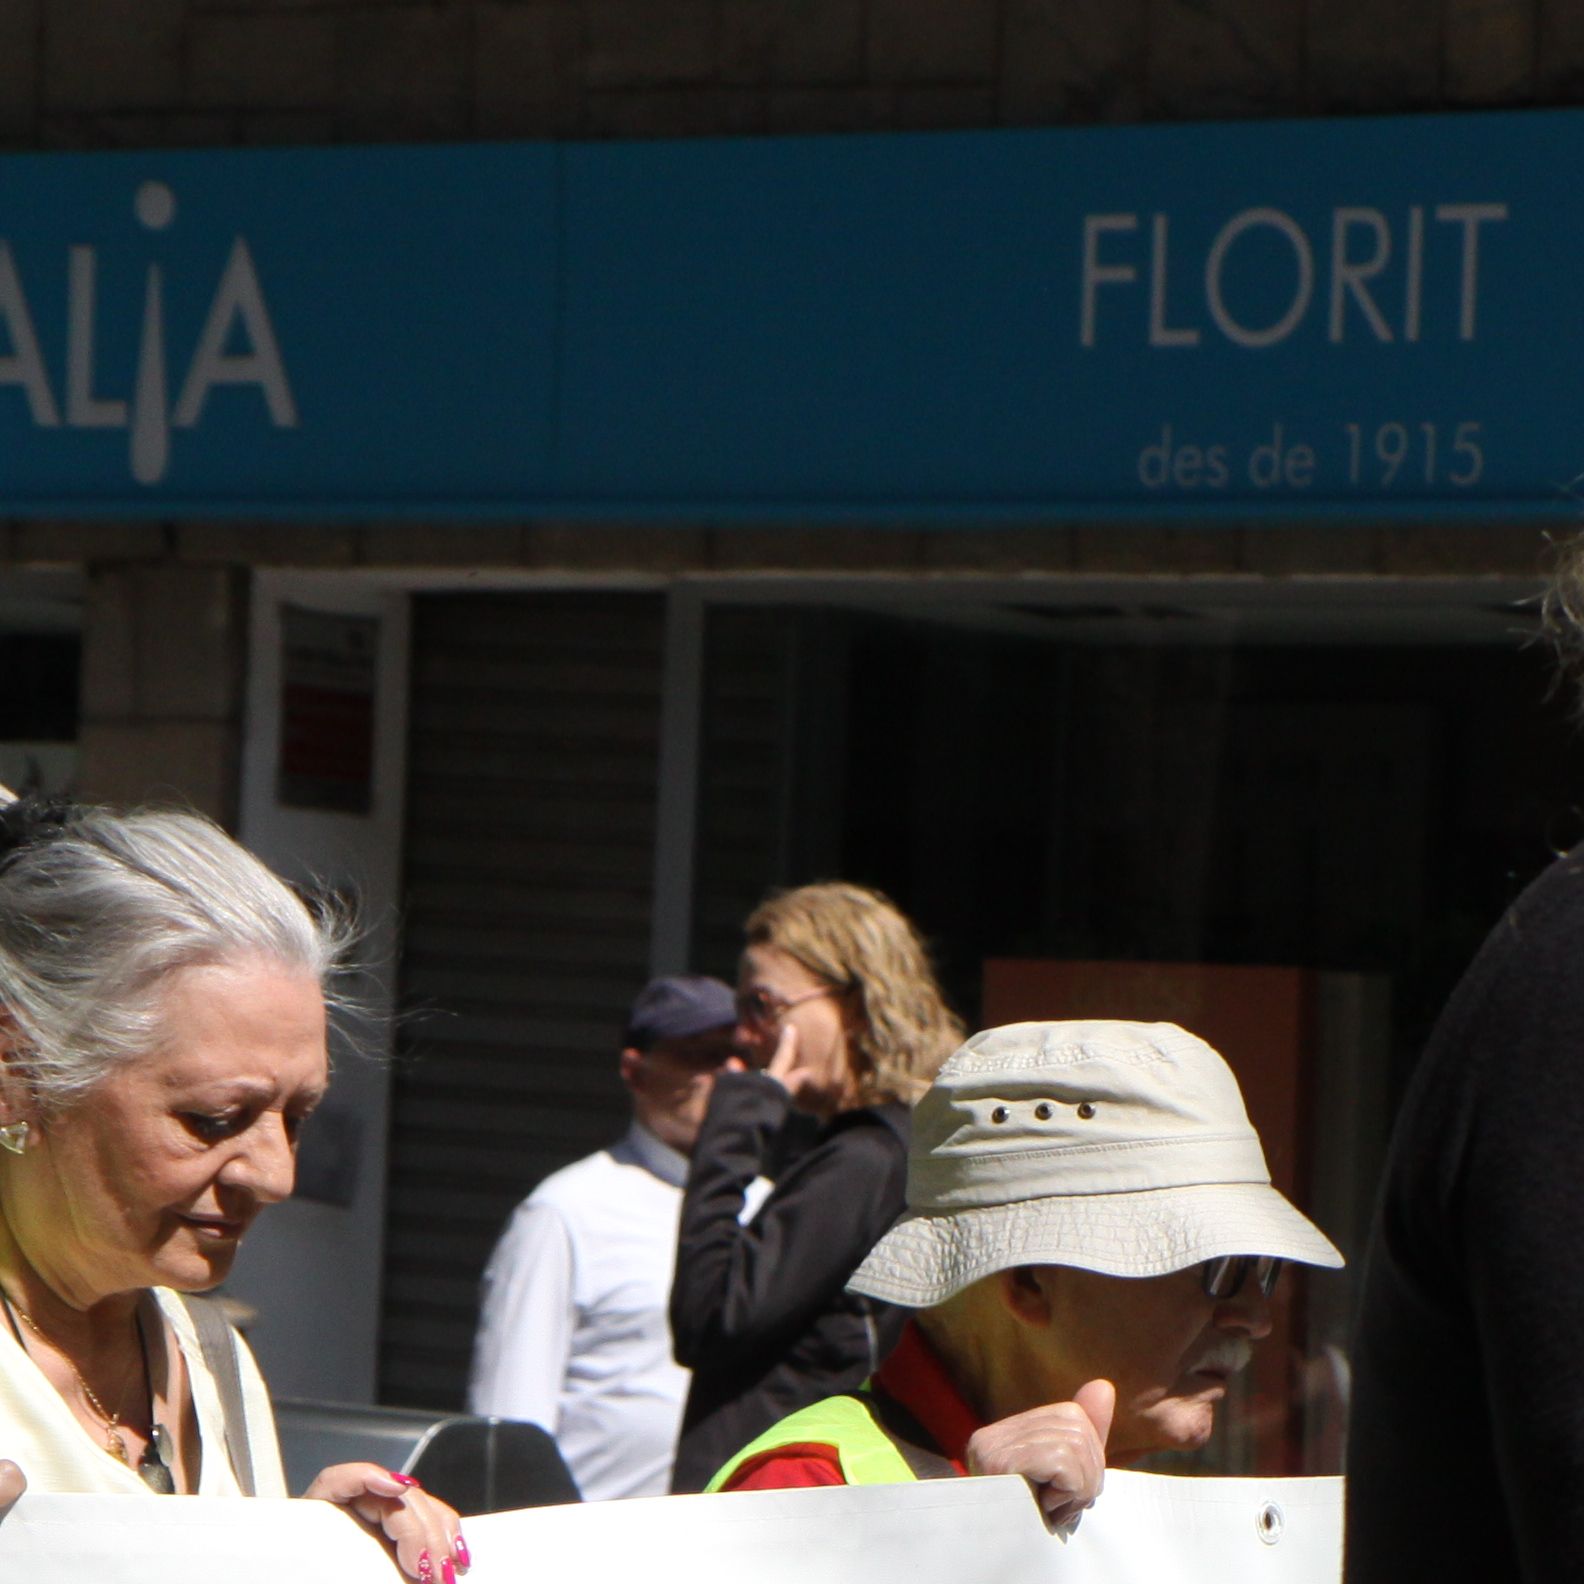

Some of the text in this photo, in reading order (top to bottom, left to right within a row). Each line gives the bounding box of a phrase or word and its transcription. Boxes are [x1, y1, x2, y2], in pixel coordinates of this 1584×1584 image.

[1079, 202, 1508, 348] FLORIT
[1138, 421, 1485, 489] des de 1915
